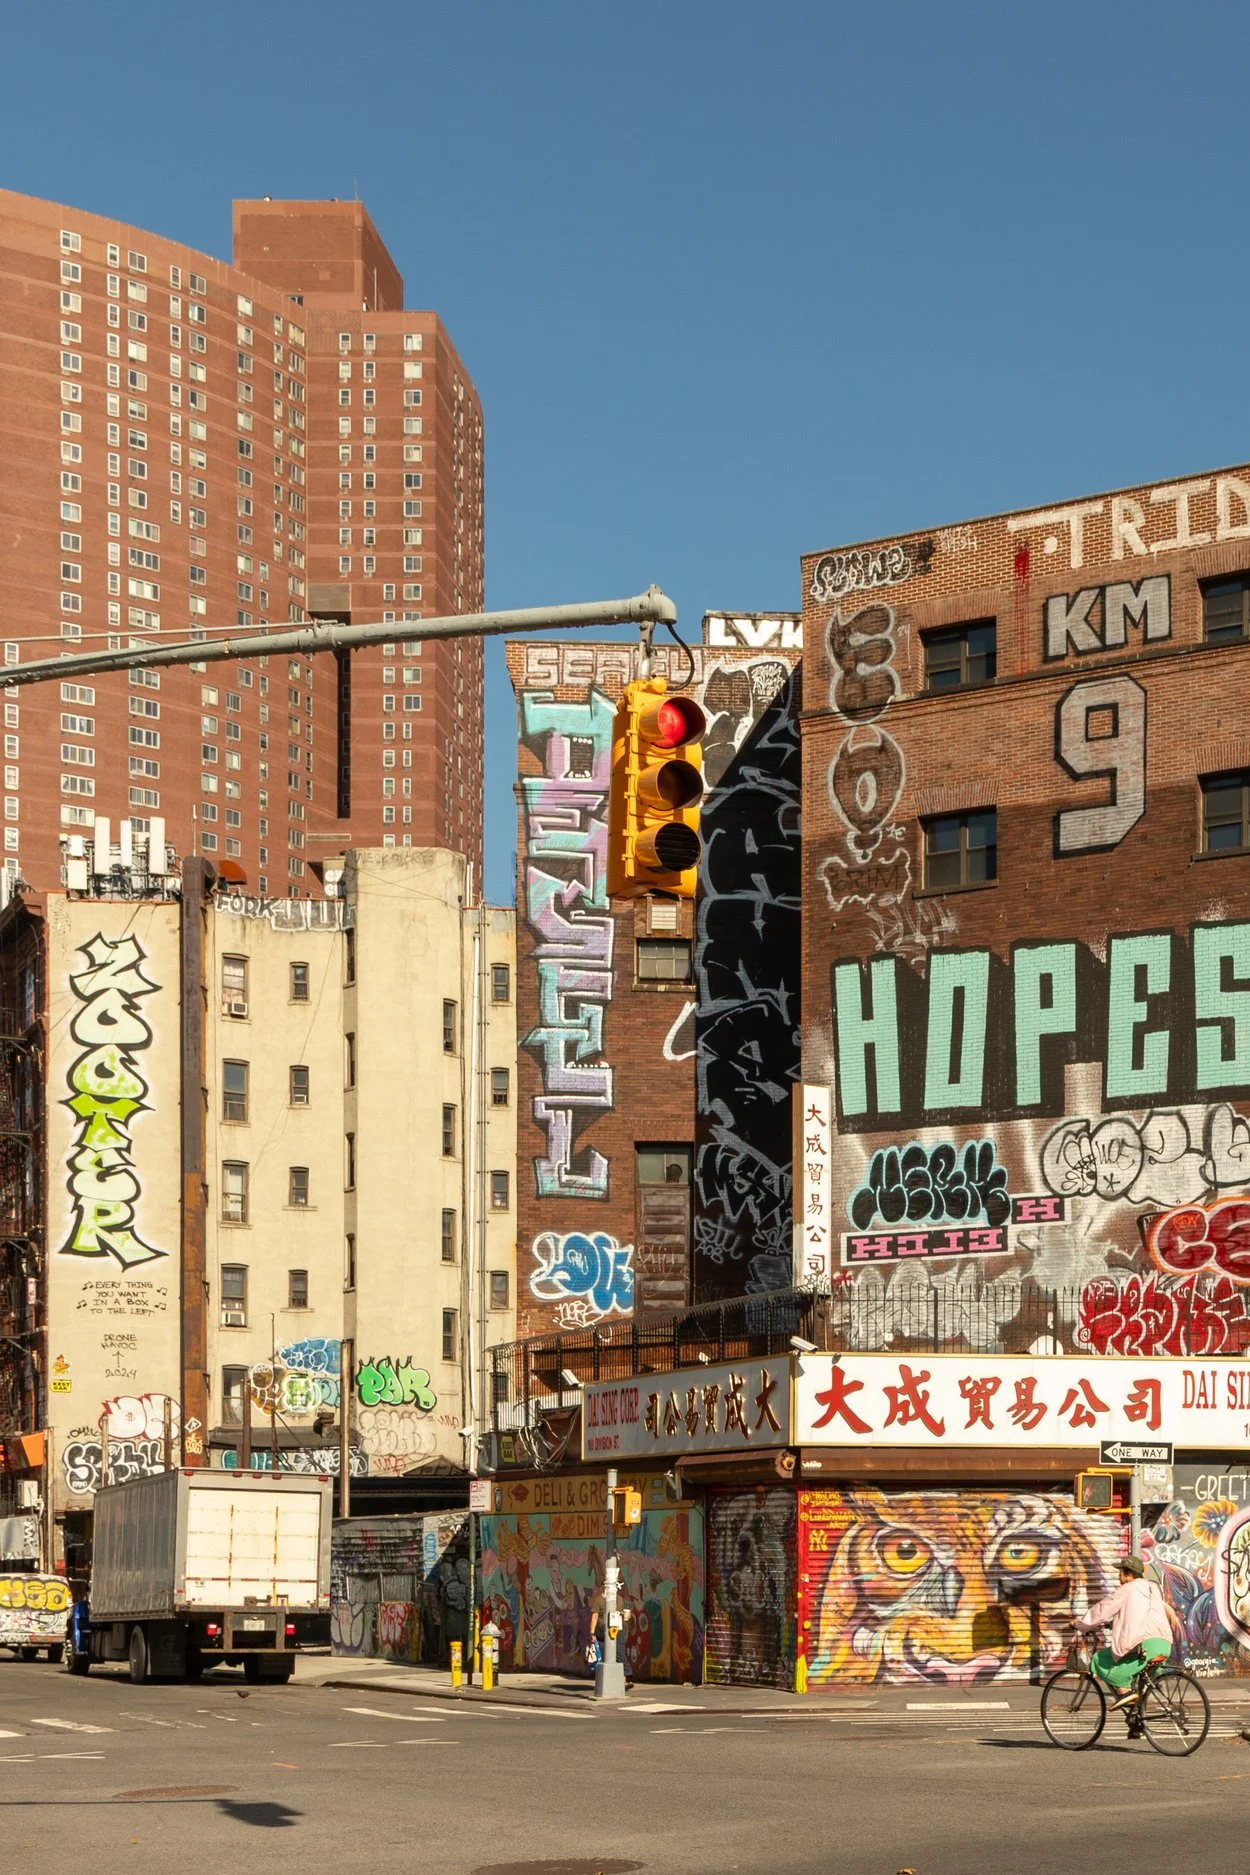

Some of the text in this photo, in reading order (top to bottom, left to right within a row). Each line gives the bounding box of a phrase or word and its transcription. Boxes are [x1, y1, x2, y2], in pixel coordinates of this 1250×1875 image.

[1044, 573, 1173, 662] KM
[1053, 673, 1147, 859] 9
[805, 1104, 827, 1276] 大成貿易公司
[95, 1281, 153, 1289] EVERY THING
[131, 1308, 155, 1317] LEFT
[101, 1342, 138, 1350] HAVOC
[811, 1364, 1162, 1437] 大成貿易公司
[1182, 1370, 1217, 1409] DAI
[601, 1389, 618, 1425] SING
[1112, 1448, 1163, 1458] ONE WAY
[535, 1483, 562, 1507] DELI
[567, 1481, 575, 1506] &
[578, 1515, 600, 1537] DIM
